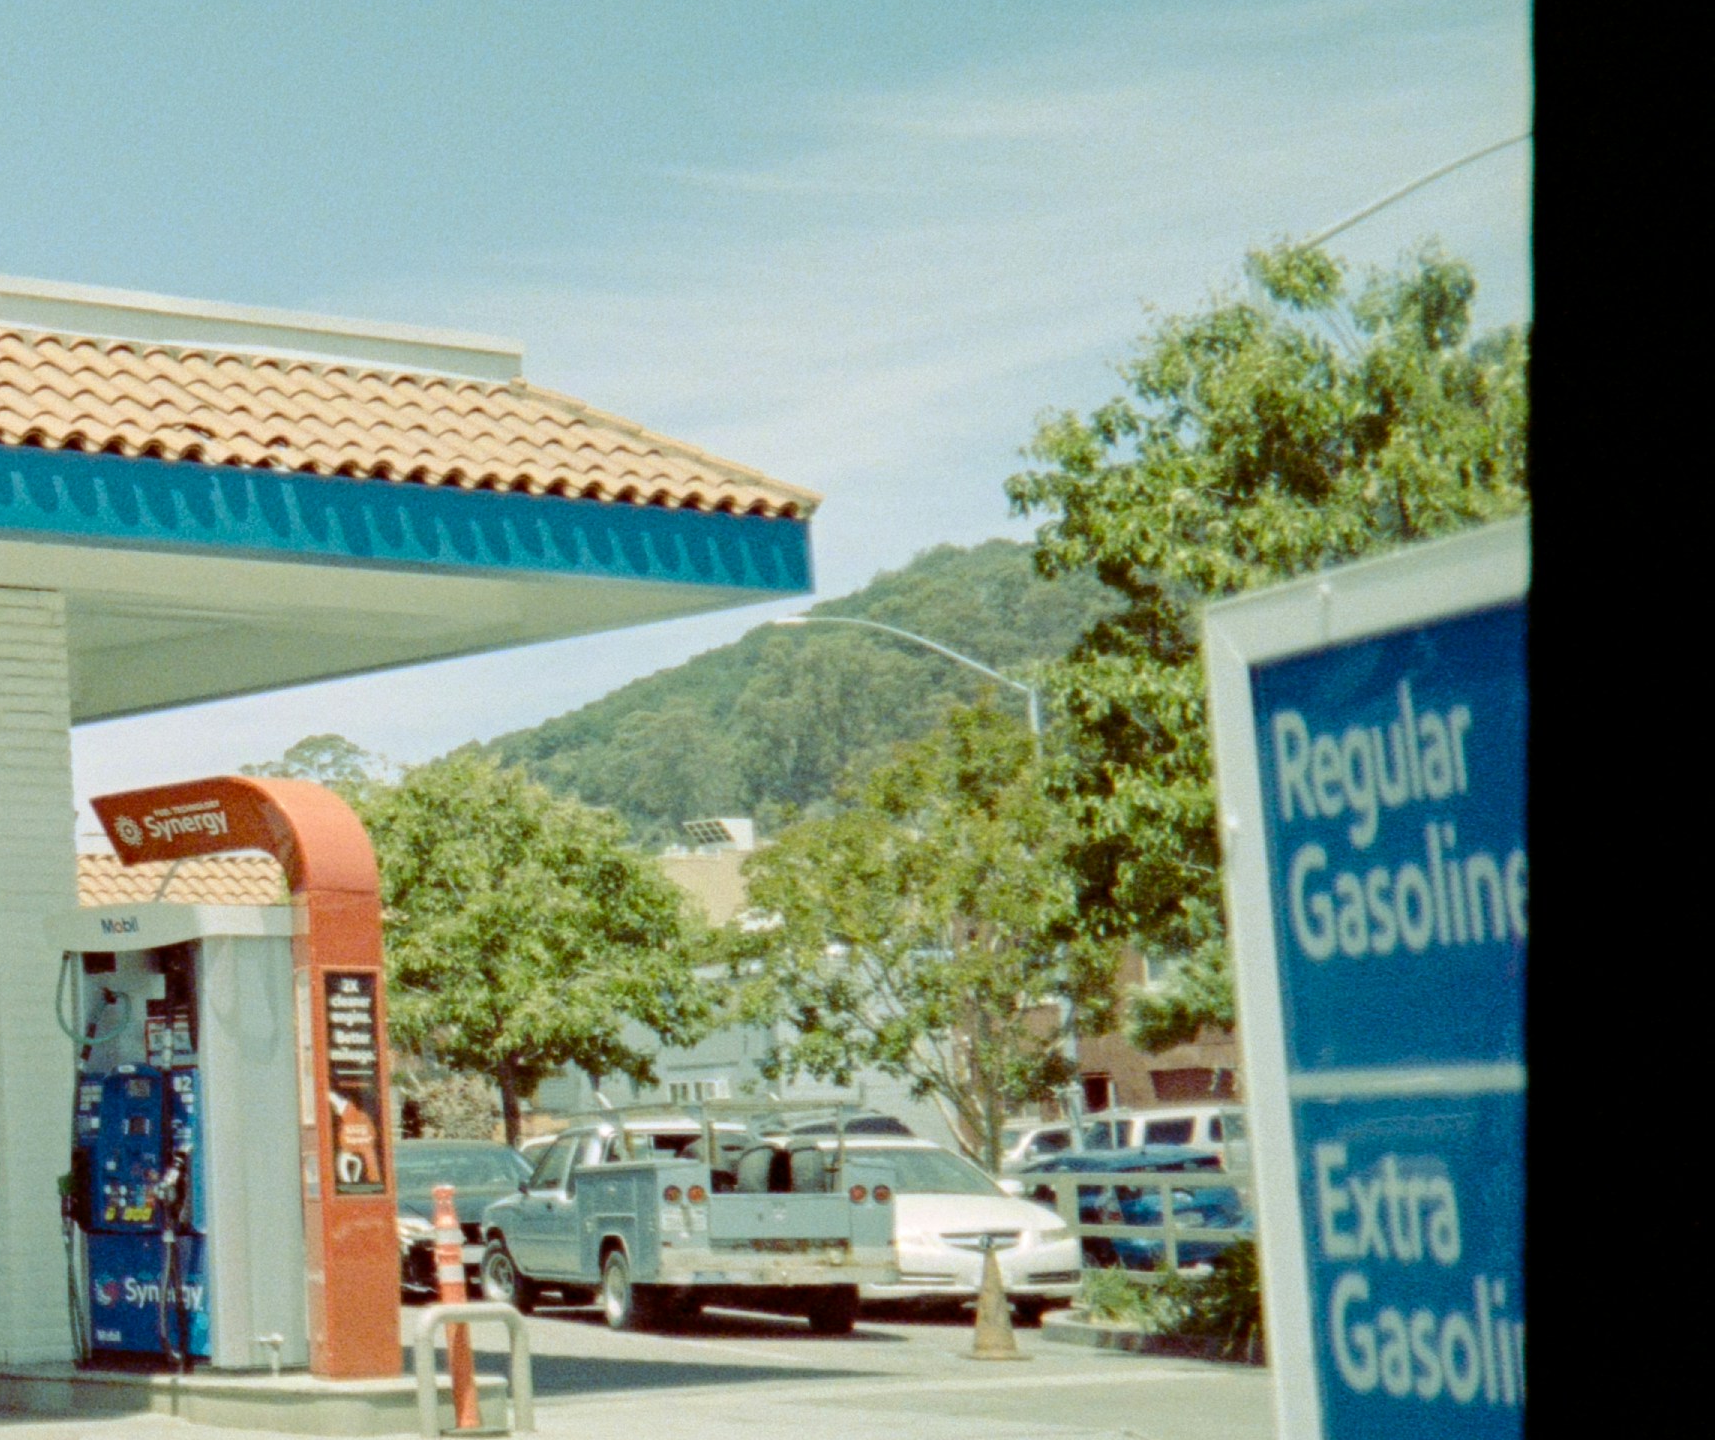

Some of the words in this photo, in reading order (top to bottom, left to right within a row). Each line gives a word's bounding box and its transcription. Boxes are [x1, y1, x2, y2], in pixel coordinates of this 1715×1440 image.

[1273, 678, 1472, 850] Regular
[142, 810, 229, 843] Synergy
[100, 916, 140, 934] Mobil
[1315, 1139, 1462, 1267] Extra
